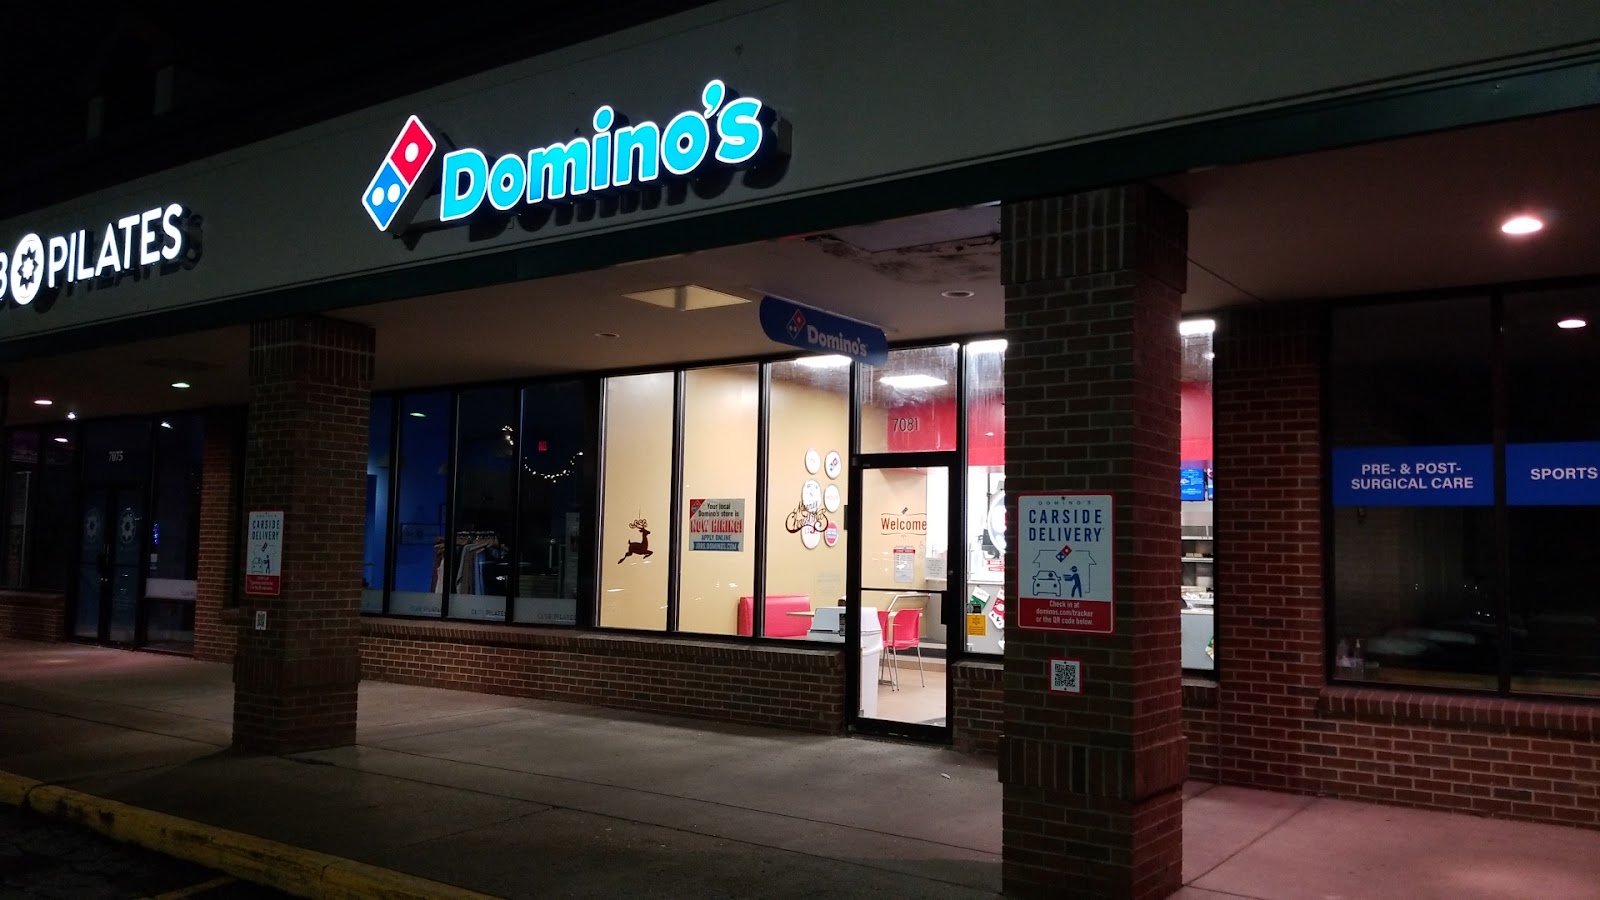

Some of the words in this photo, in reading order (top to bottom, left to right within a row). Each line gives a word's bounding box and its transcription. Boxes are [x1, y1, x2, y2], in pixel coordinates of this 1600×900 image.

[440, 79, 764, 222] Domino's
[47, 203, 184, 289] PILATES
[807, 323, 869, 357] Domino's
[892, 417, 919, 432] 7081
[1361, 463, 1396, 476] PRE-
[1399, 463, 1411, 475] &
[1415, 462, 1462, 475] POST-
[1530, 467, 1599, 481] SPORTS
[1351, 478, 1428, 490] SURGICAL
[1430, 477, 1474, 489] CARE
[719, 502, 731, 510] local
[1029, 509, 1103, 524] CARSIDE
[252, 519, 280, 530] CARSIDE
[691, 519, 708, 533] NOW
[711, 519, 742, 533] HIRING!
[880, 517, 927, 531] Welcome
[252, 531, 279, 541] DELIVERY
[1029, 527, 1103, 542] DELIVERY
[1049, 600, 1066, 608] Check
[1035, 608, 1093, 617] dominos.com/tracker
[1042, 616, 1052, 624] the
[1052, 616, 1061, 625] QR
[1061, 616, 1075, 625] code
[1075, 617, 1094, 626] below.
